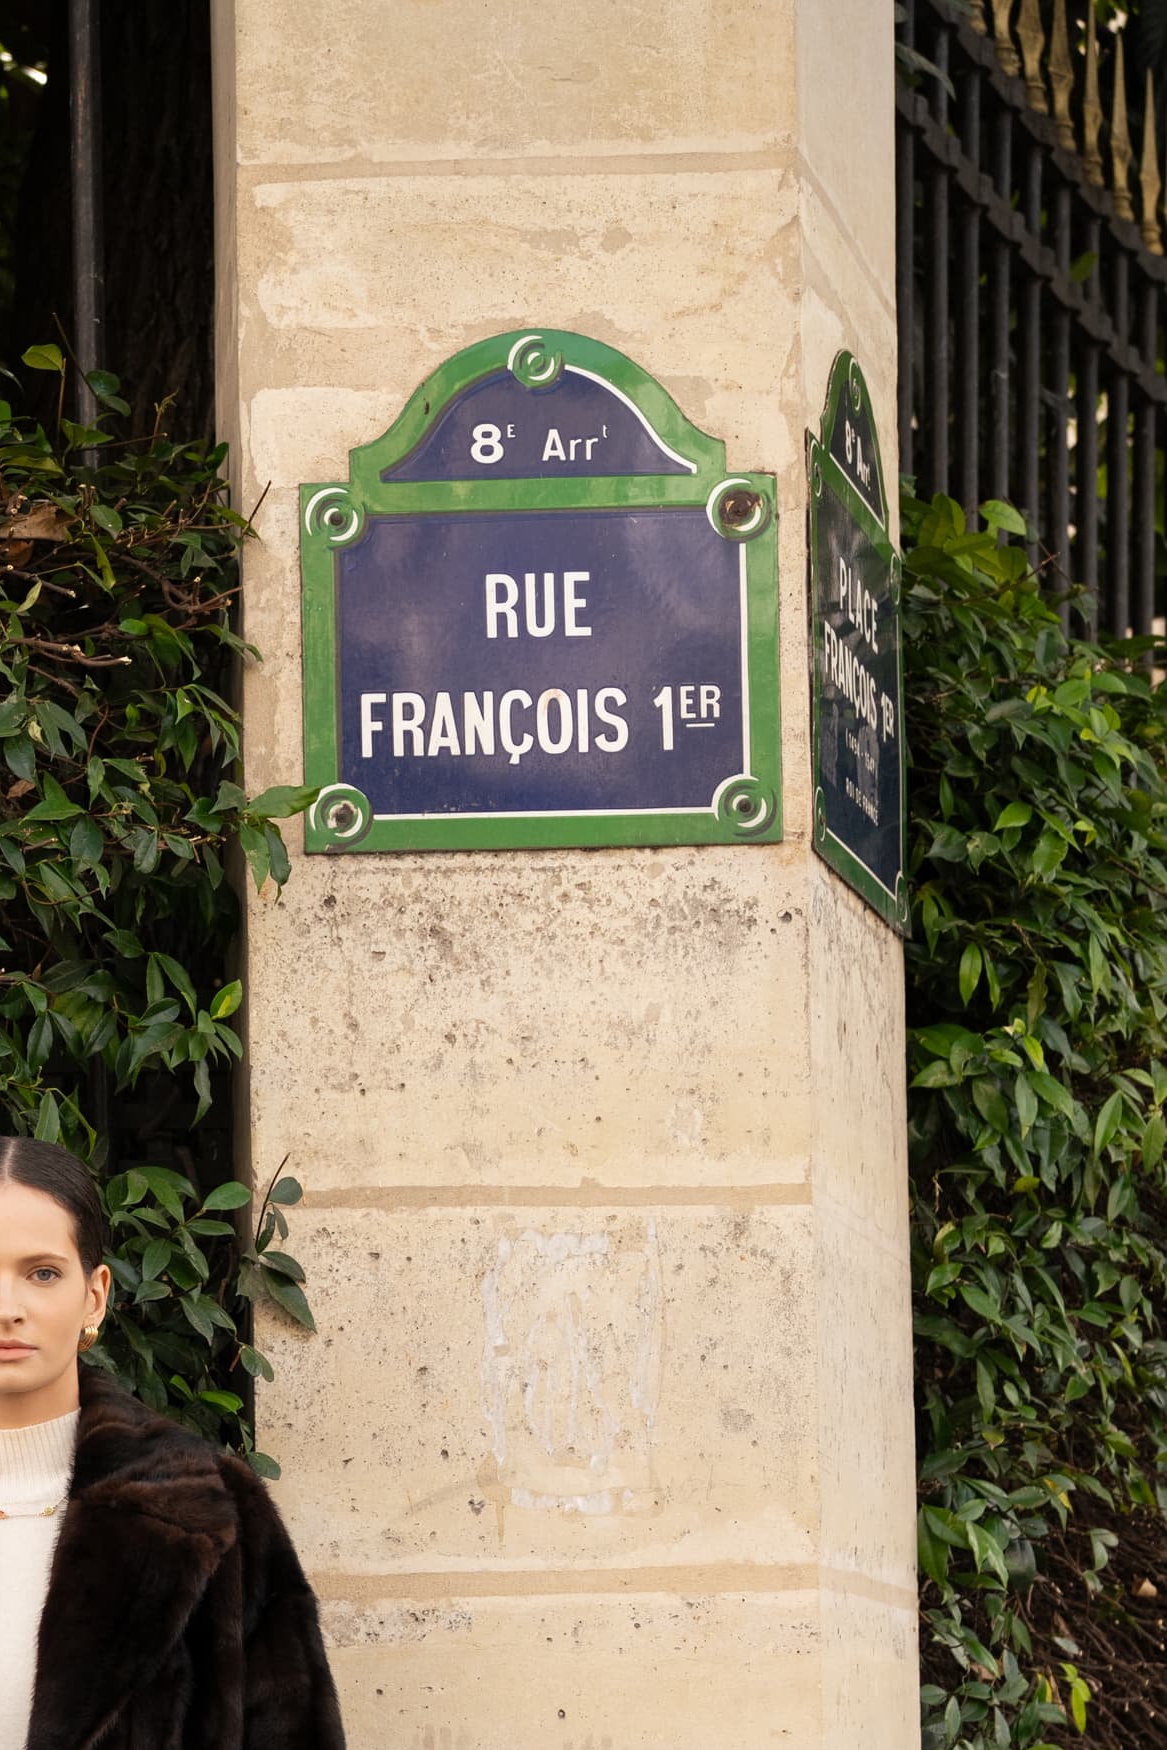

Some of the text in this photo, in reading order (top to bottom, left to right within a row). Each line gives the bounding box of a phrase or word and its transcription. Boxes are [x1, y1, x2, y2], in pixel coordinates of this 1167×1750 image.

[542, 425, 609, 462] Arrt
[485, 571, 593, 639] RUE
[840, 556, 879, 655] PLACE
[824, 620, 877, 731] FRANÇOIS
[360, 684, 721, 765] FRANÇOIS 1ER
[855, 787, 862, 808] DE
[862, 795, 879, 827] FRANCE
